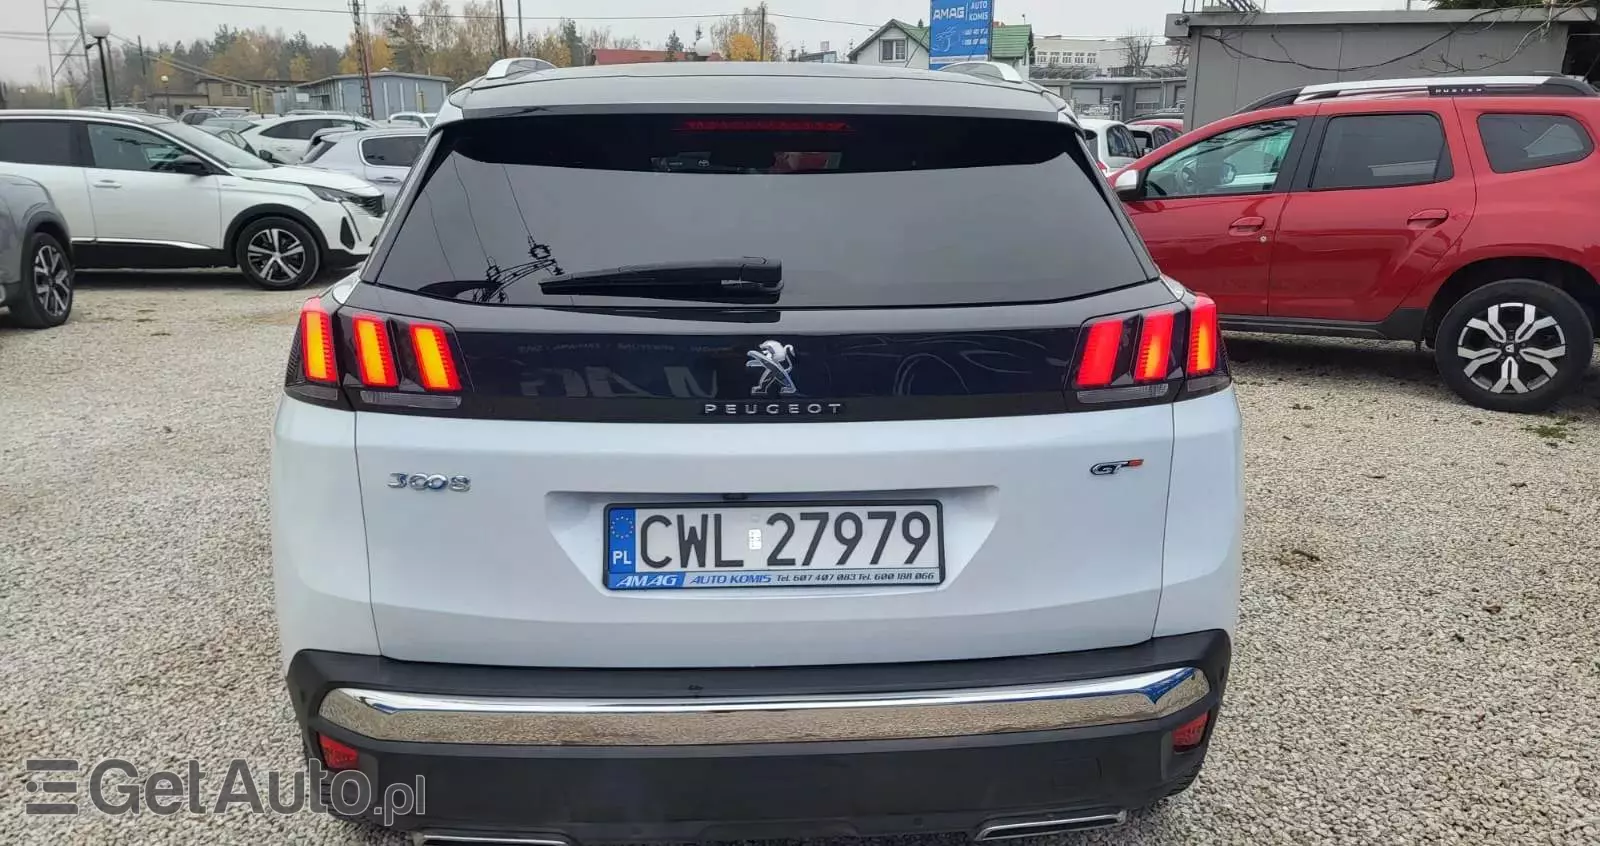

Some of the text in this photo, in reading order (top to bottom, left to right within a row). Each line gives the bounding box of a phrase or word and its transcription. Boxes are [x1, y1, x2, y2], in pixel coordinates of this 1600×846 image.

[971, 0, 988, 9] AUTO
[933, 6, 965, 20] AMAG
[969, 12, 988, 21] KOMIS
[704, 403, 841, 414] PEUGEOT
[1089, 459, 1144, 475] GT
[387, 472, 471, 492] 3008
[640, 511, 931, 568] CWL 27979
[612, 551, 632, 565] PL
[616, 574, 678, 587] AMAG
[690, 574, 772, 584] AUTO KOMIS
[776, 574, 791, 582] Tel.
[793, 574, 813, 582] 607
